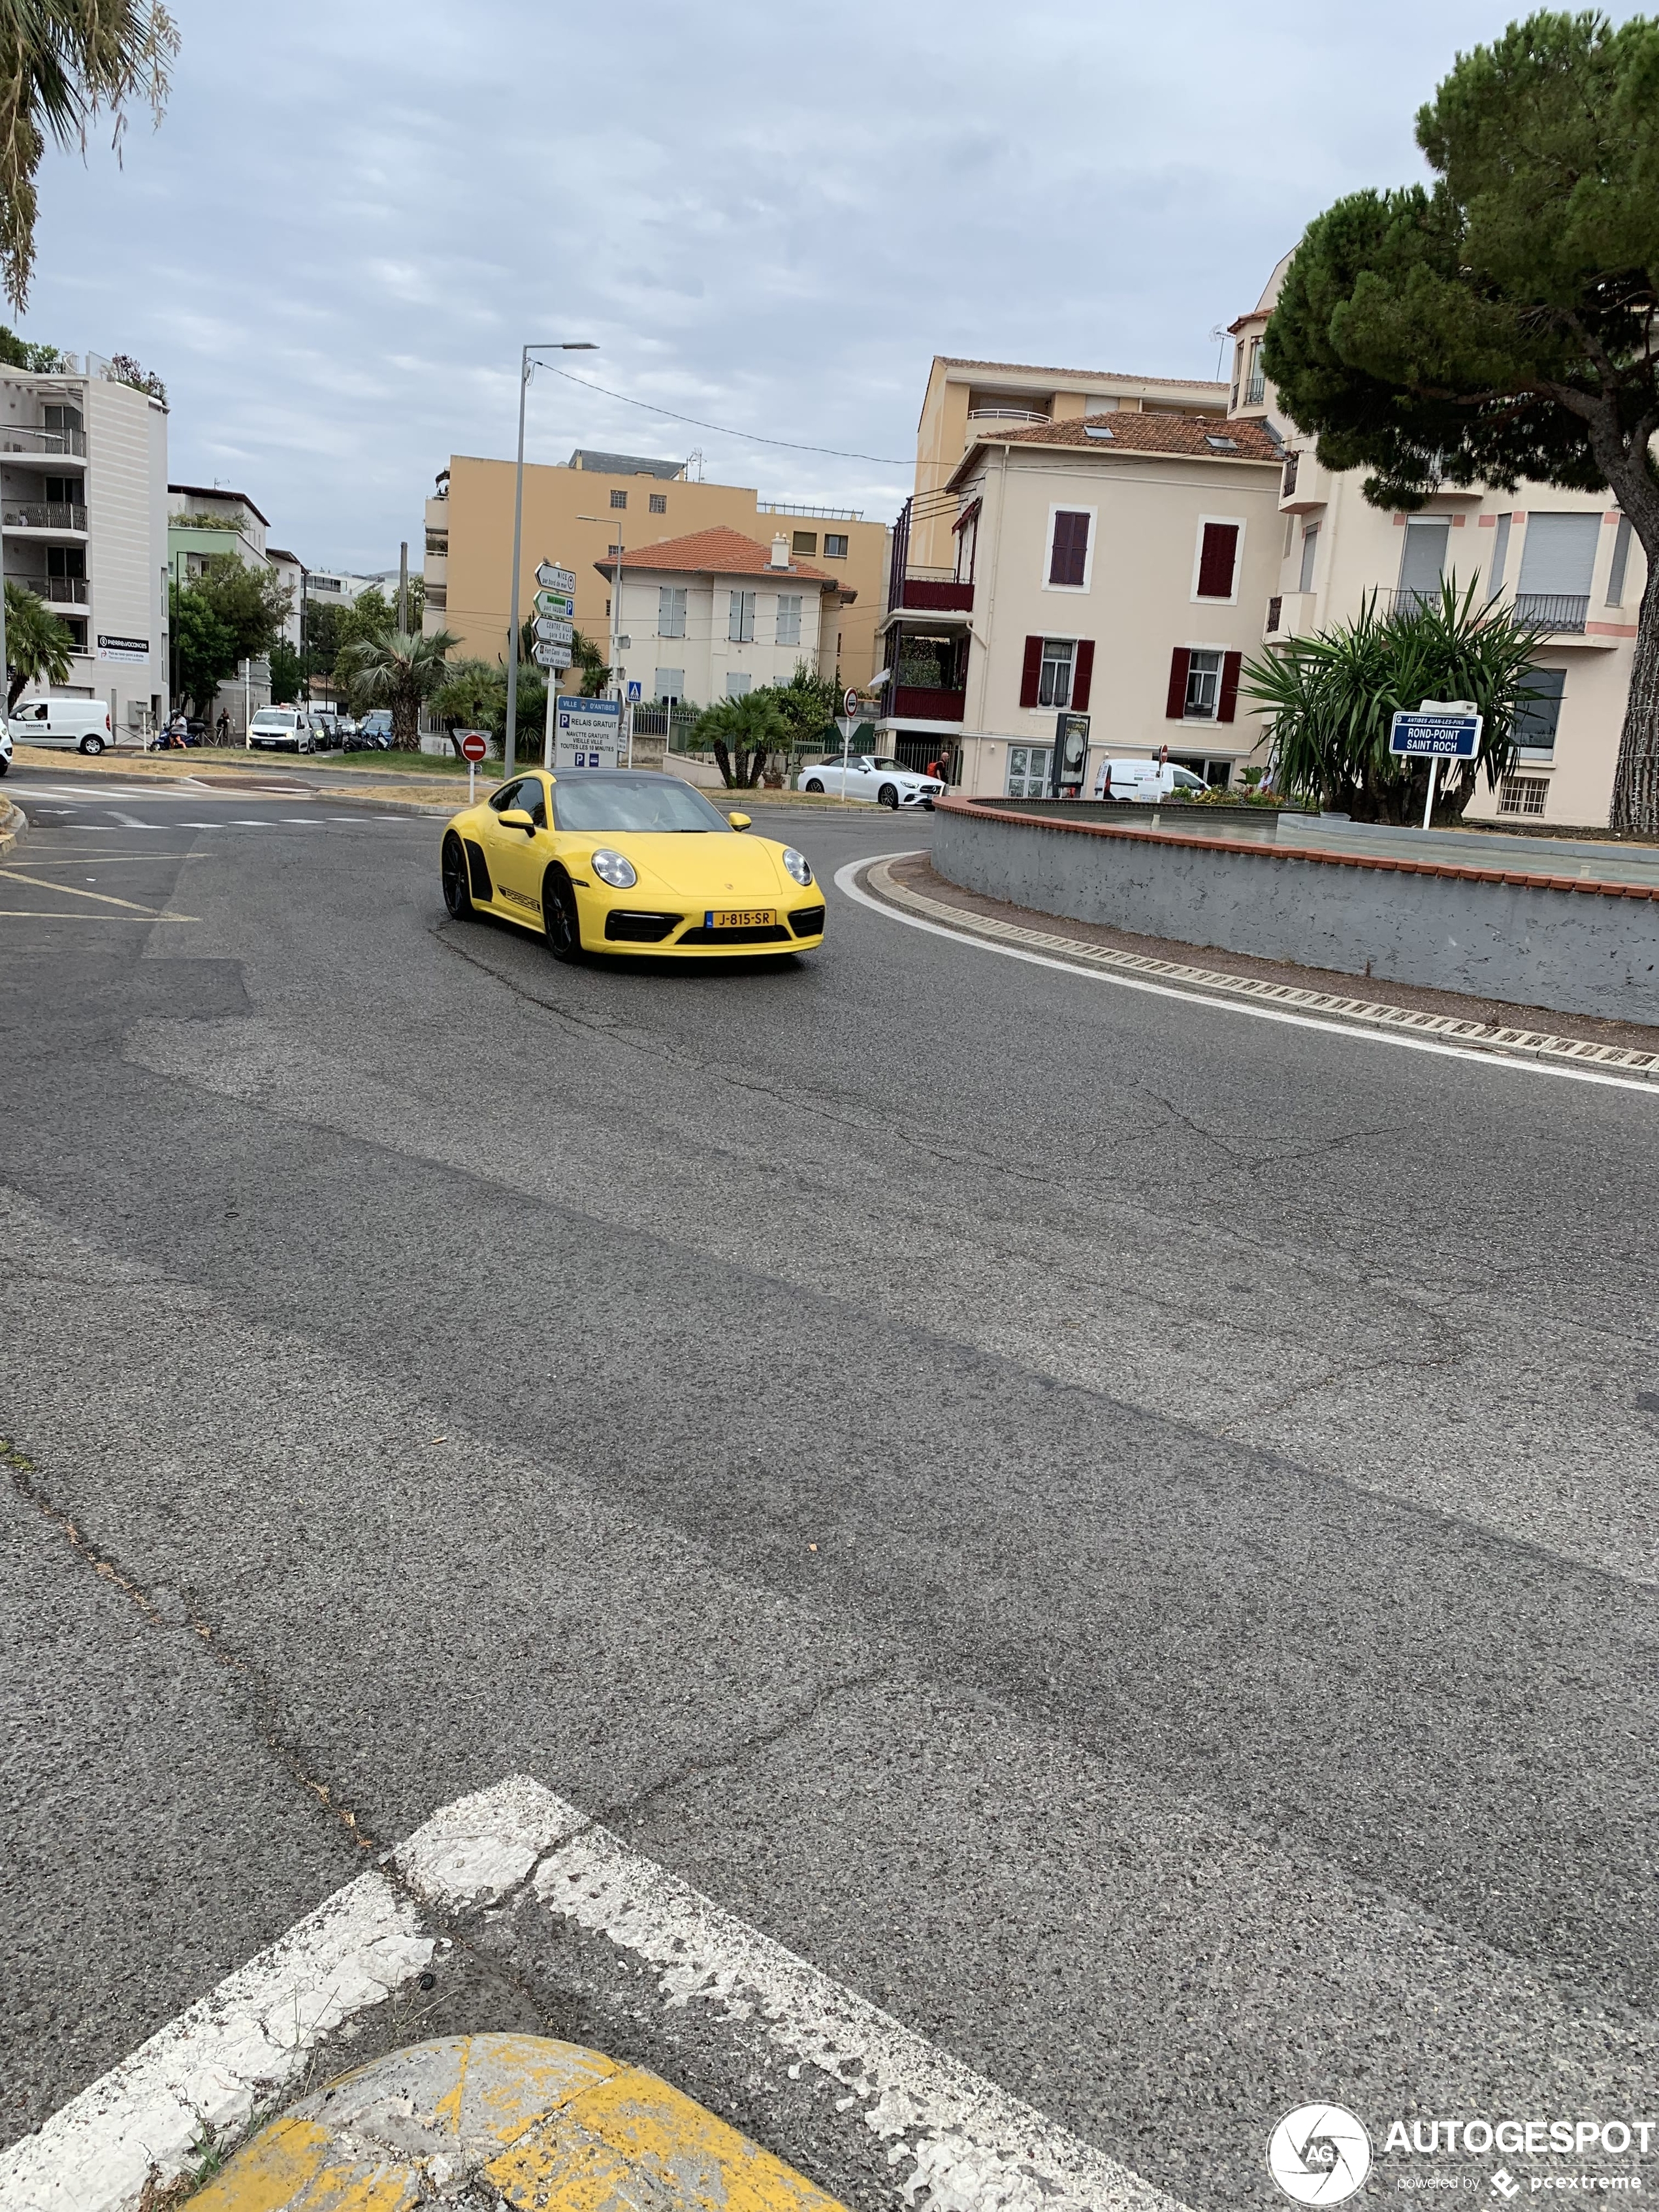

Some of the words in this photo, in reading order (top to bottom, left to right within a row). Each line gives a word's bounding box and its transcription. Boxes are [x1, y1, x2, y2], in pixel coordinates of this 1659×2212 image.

[557, 571, 568, 581] NICE
[553, 605, 566, 615] VAUBAN
[547, 622, 561, 631] CENTRE
[590, 703, 615, 711] D'ANTIBES
[562, 715, 568, 726] P
[571, 718, 592, 727] RELAIS
[593, 720, 617, 728] GRATUIT
[1408, 728, 1460, 740] ROND-POINT
[1406, 739, 1431, 750] SAINT
[1432, 741, 1457, 752] ROCH
[506, 890, 538, 909] PORSCHE
[719, 912, 769, 925] J-815-SR
